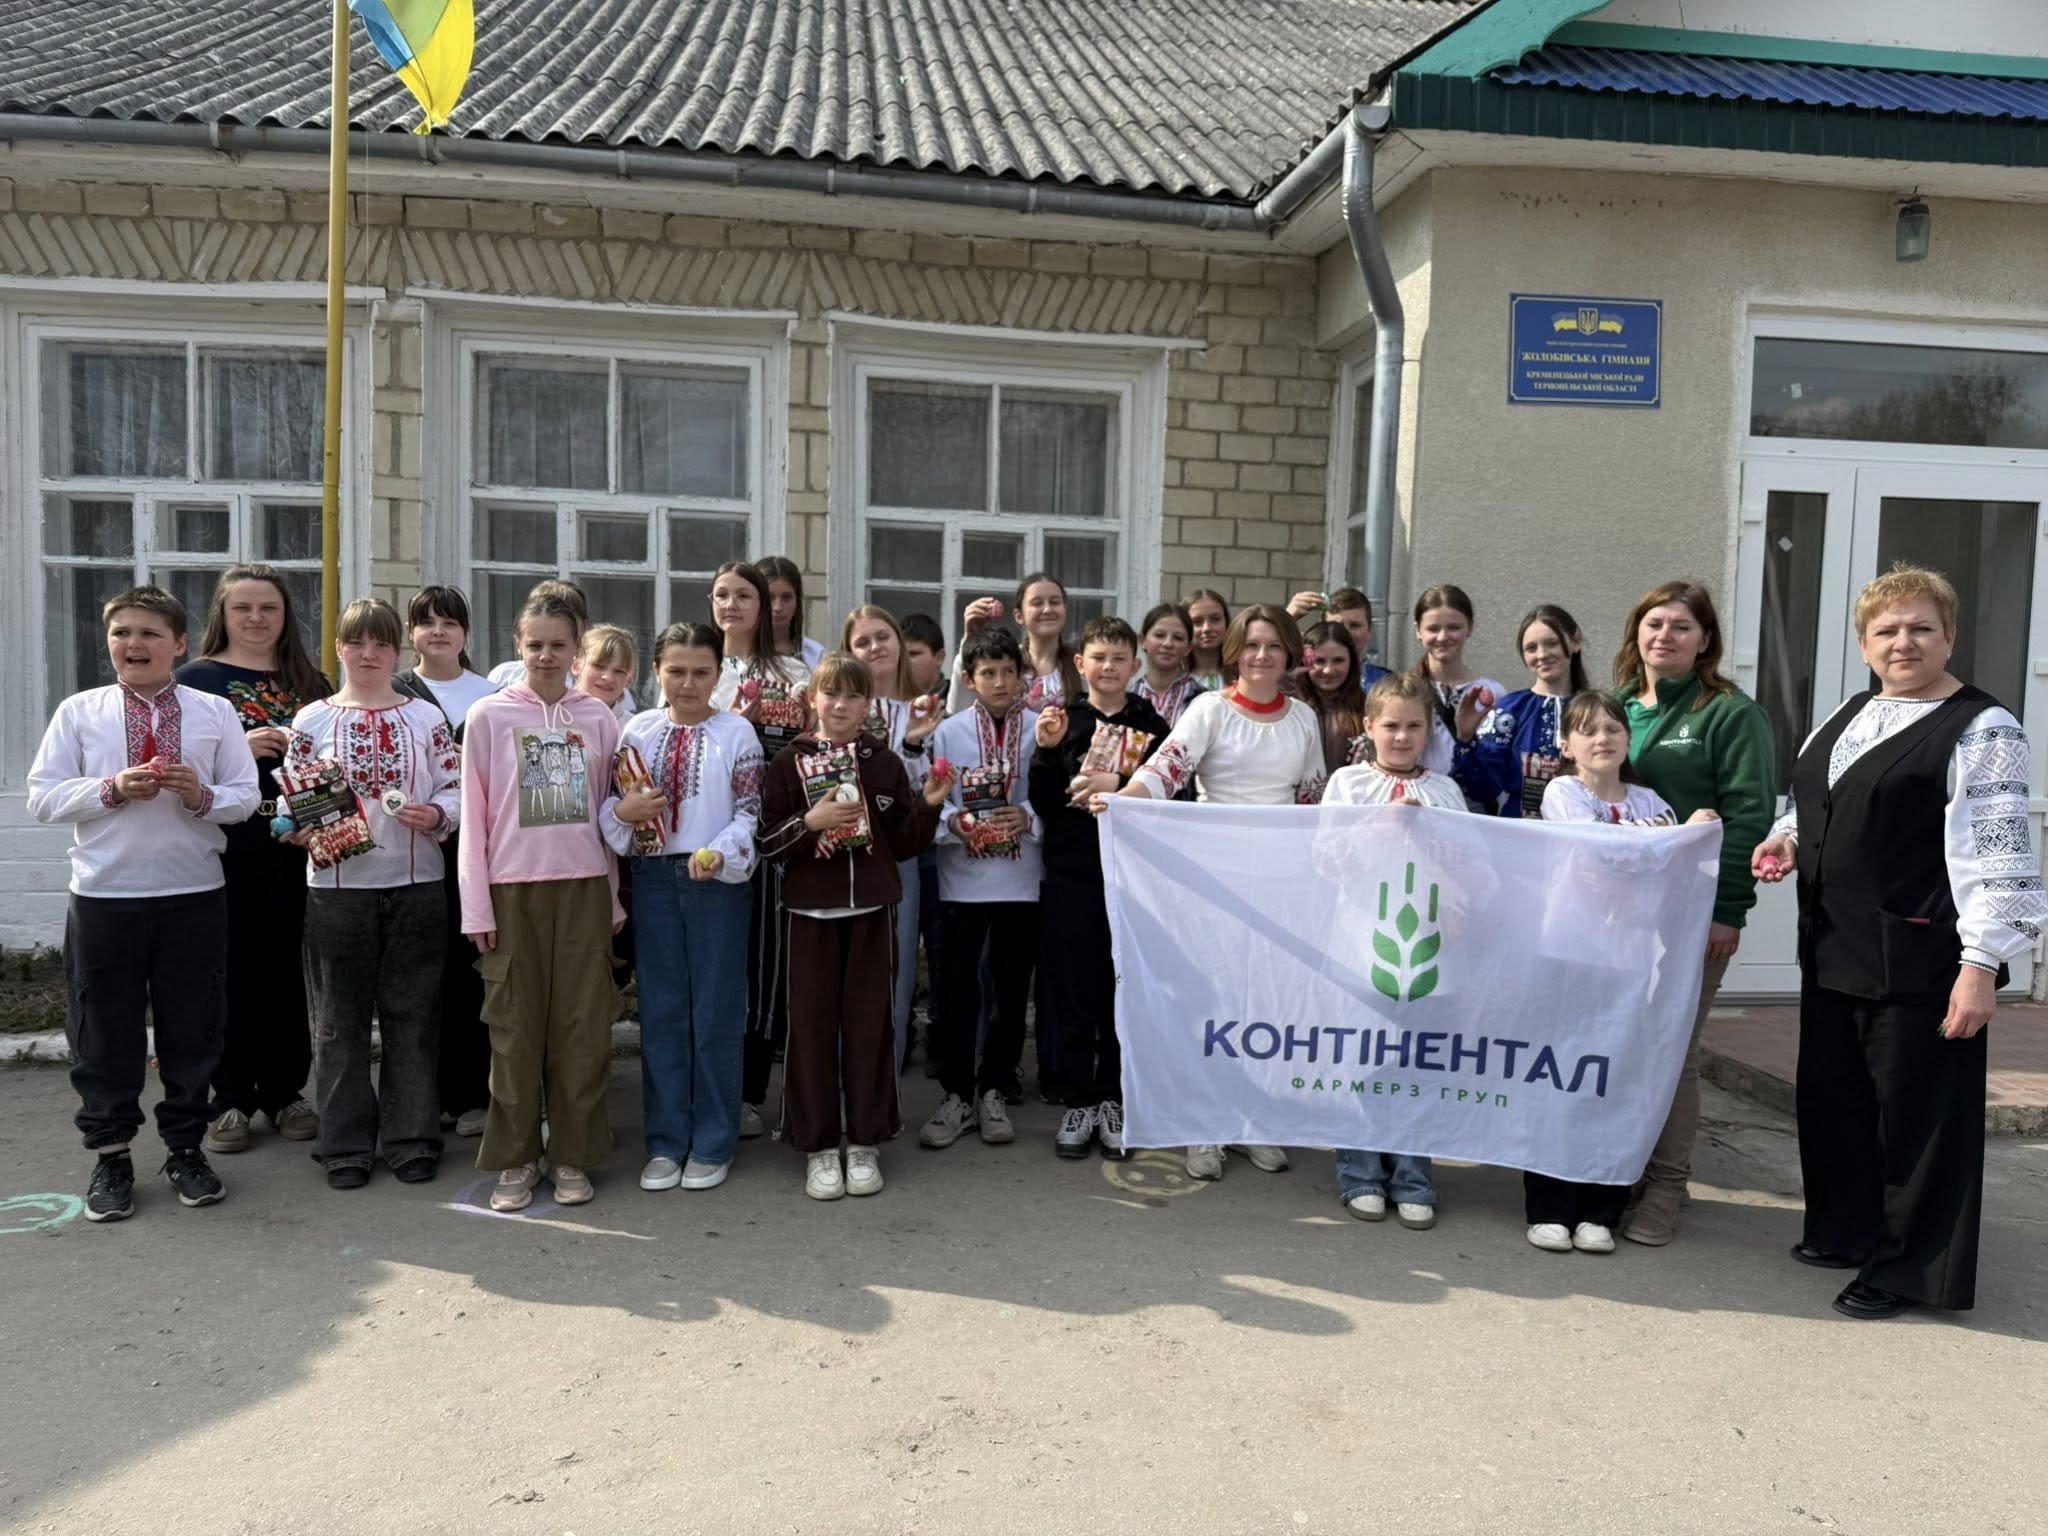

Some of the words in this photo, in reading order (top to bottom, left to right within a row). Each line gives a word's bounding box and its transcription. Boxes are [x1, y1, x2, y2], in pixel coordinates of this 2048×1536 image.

[1602, 355, 1650, 365] ГІМНАЗІЯ
[1203, 1018, 1610, 1098] КОНТІНЕНТАЛ
[1290, 1077, 1420, 1098] ФАРМЕРЗ
[1440, 1087, 1508, 1108] ГРУП
